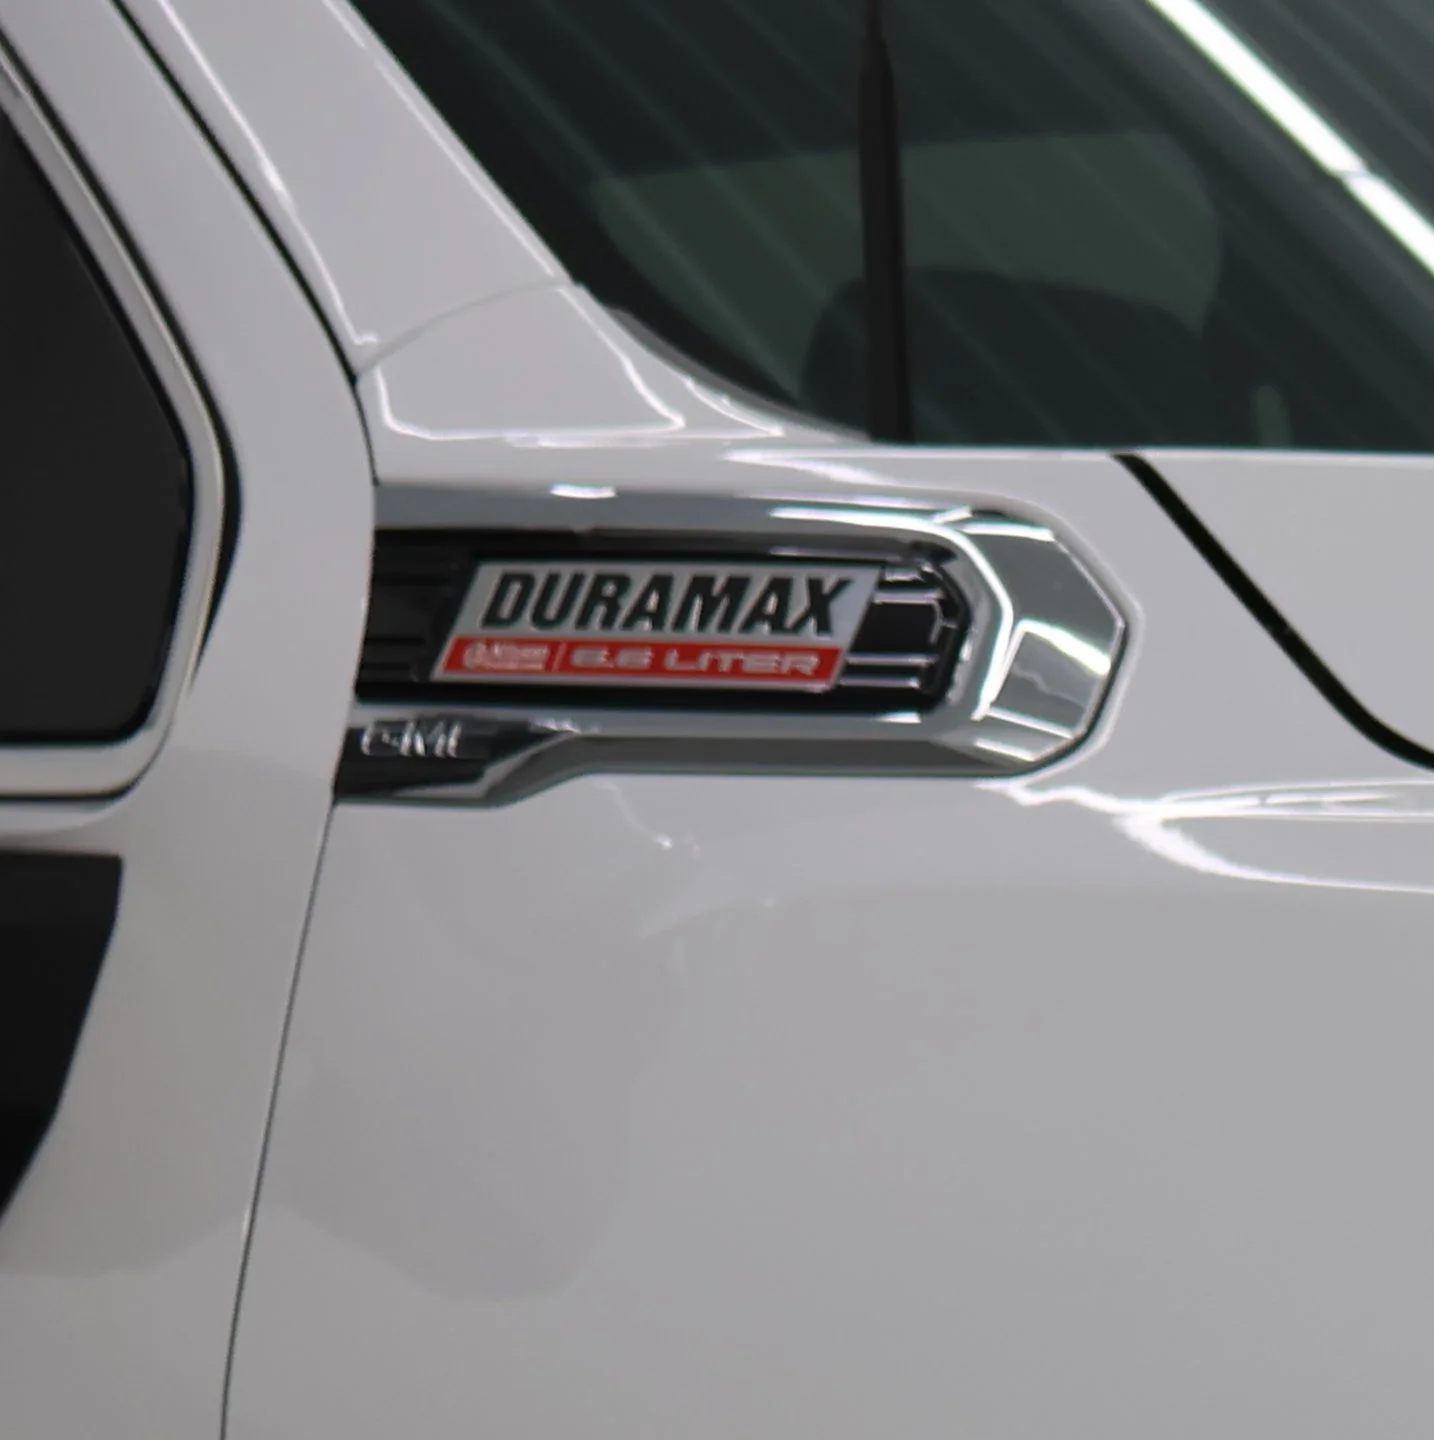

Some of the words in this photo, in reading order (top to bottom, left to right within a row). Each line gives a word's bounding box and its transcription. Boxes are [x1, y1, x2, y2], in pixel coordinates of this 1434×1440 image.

[480, 571, 853, 636] DURAMAX
[571, 647, 653, 669] 6.6
[664, 648, 820, 677] LITER
